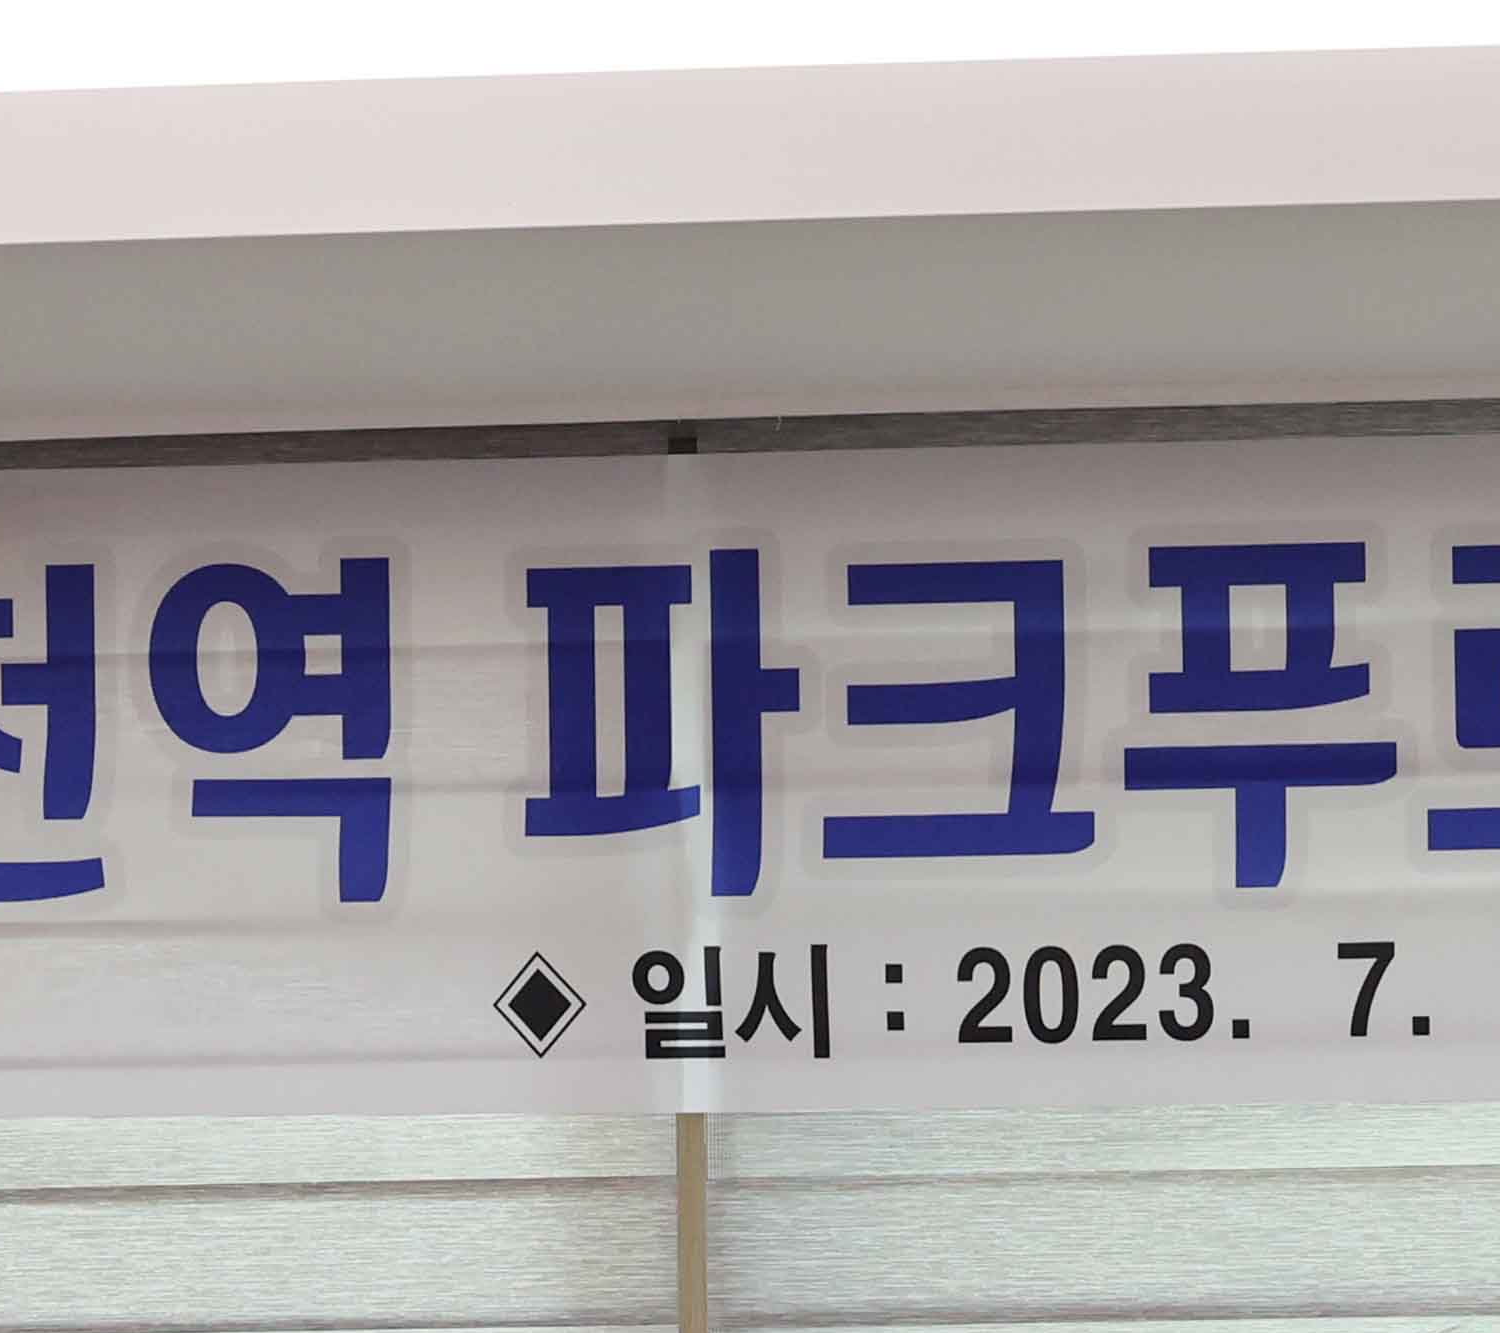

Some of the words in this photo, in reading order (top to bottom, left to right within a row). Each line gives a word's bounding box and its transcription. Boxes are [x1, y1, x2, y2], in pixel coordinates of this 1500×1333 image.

[631, 942, 832, 1061] 일시
[955, 942, 1252, 1045] 2023.
[1336, 940, 1431, 1038] 7.
